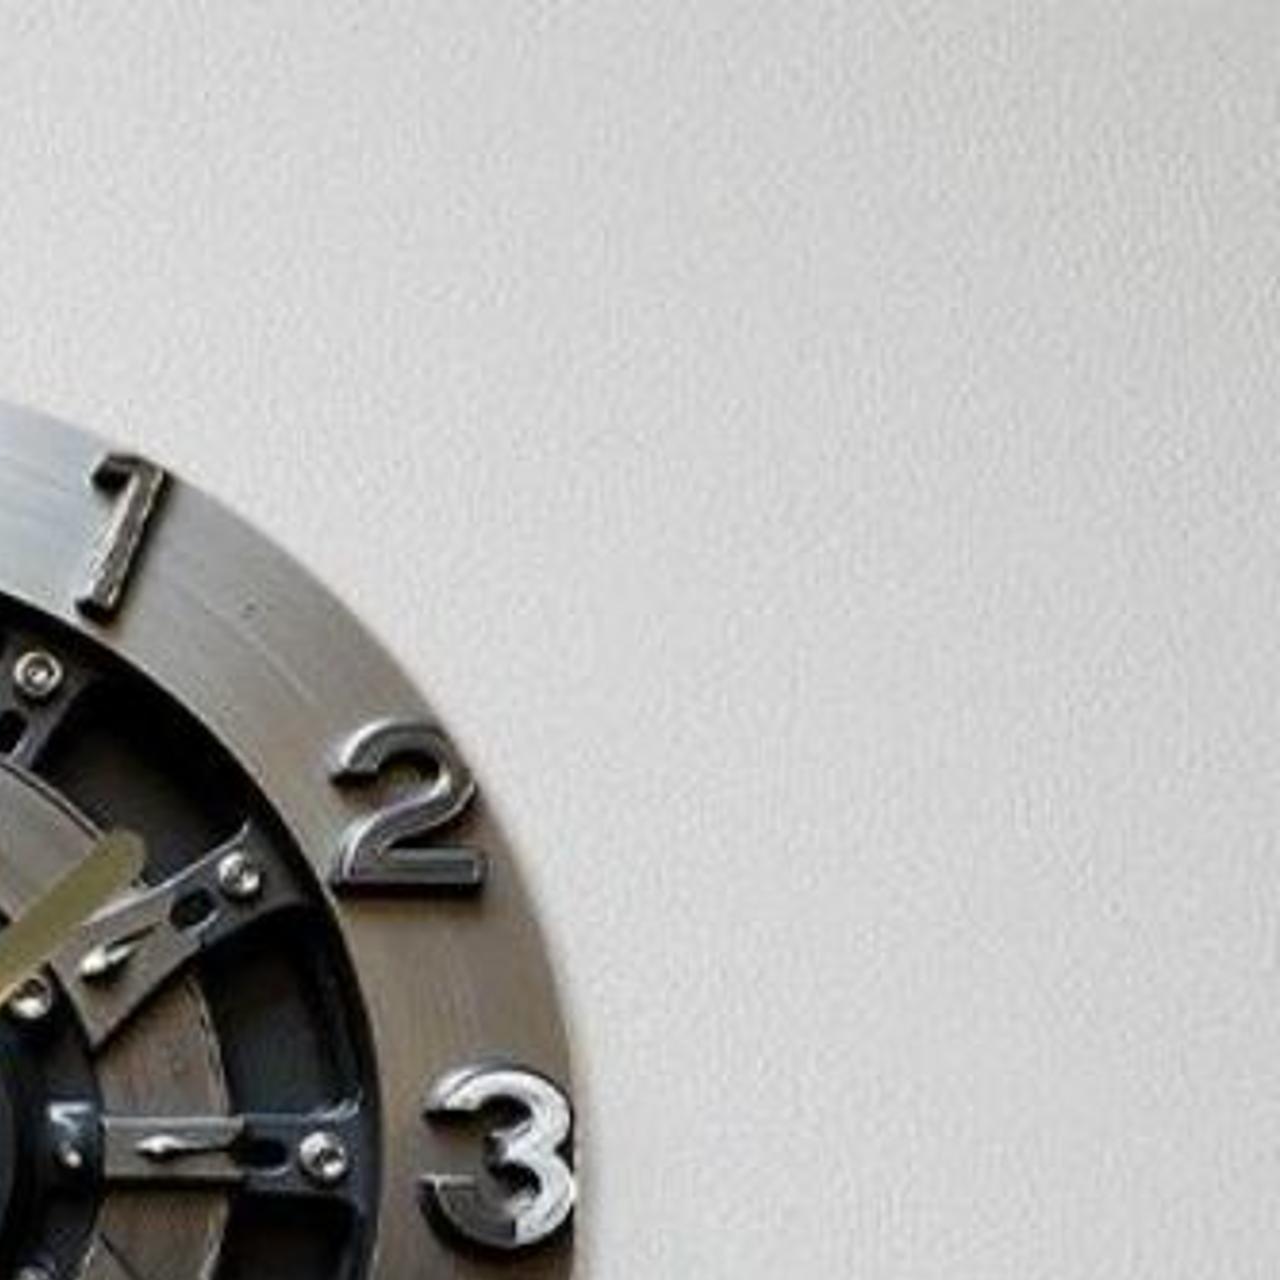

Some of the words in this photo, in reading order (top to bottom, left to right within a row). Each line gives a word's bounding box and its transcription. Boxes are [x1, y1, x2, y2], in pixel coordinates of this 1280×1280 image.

[75, 452, 175, 626] 1
[332, 718, 488, 885] 2
[420, 1060, 576, 1242] 3
